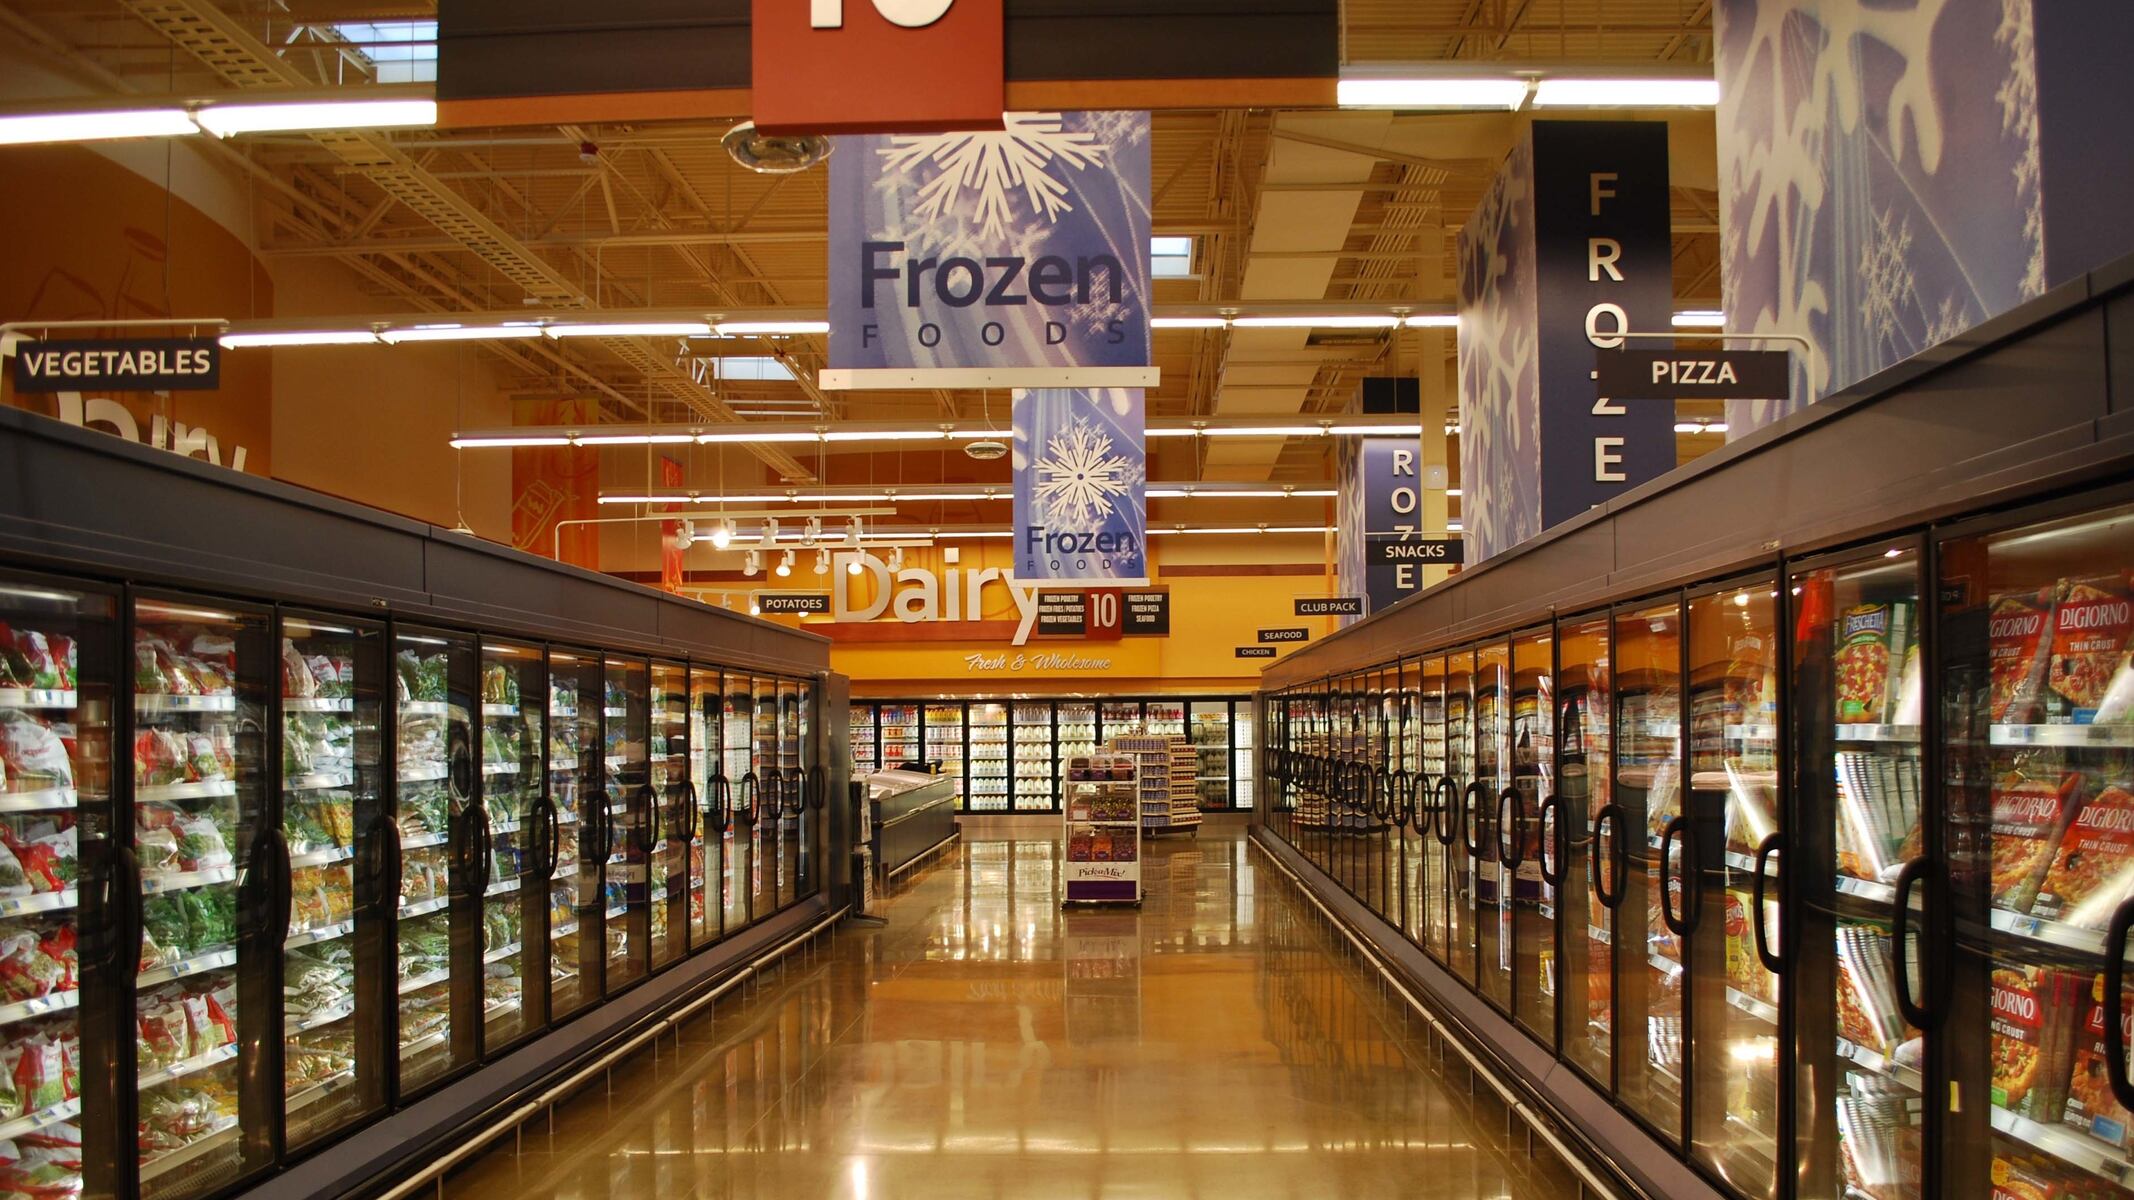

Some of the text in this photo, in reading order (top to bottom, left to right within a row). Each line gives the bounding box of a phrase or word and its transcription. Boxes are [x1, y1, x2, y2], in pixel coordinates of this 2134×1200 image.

[861, 241, 1122, 308] Frozen
[862, 321, 1125, 348] FOODS
[1584, 172, 1627, 509] FROE
[24, 350, 210, 376] VEGETABLES
[1652, 360, 1737, 384] PIZZA
[1026, 526, 1134, 555] Frozen
[1385, 545, 1445, 558] SNACKS
[1027, 559, 1136, 571] FOODS
[766, 599, 822, 608] POTATOES
[833, 548, 1038, 646] Dairy
[1300, 602, 1356, 612] CLUB PACK
[1091, 593, 1117, 627] 10
[1264, 632, 1302, 640] SEAFOOD
[2070, 639, 2116, 651] THIN CRUST
[964, 653, 1111, 671] Fresh & Wholesome
[2099, 841, 2128, 854] CRUST
